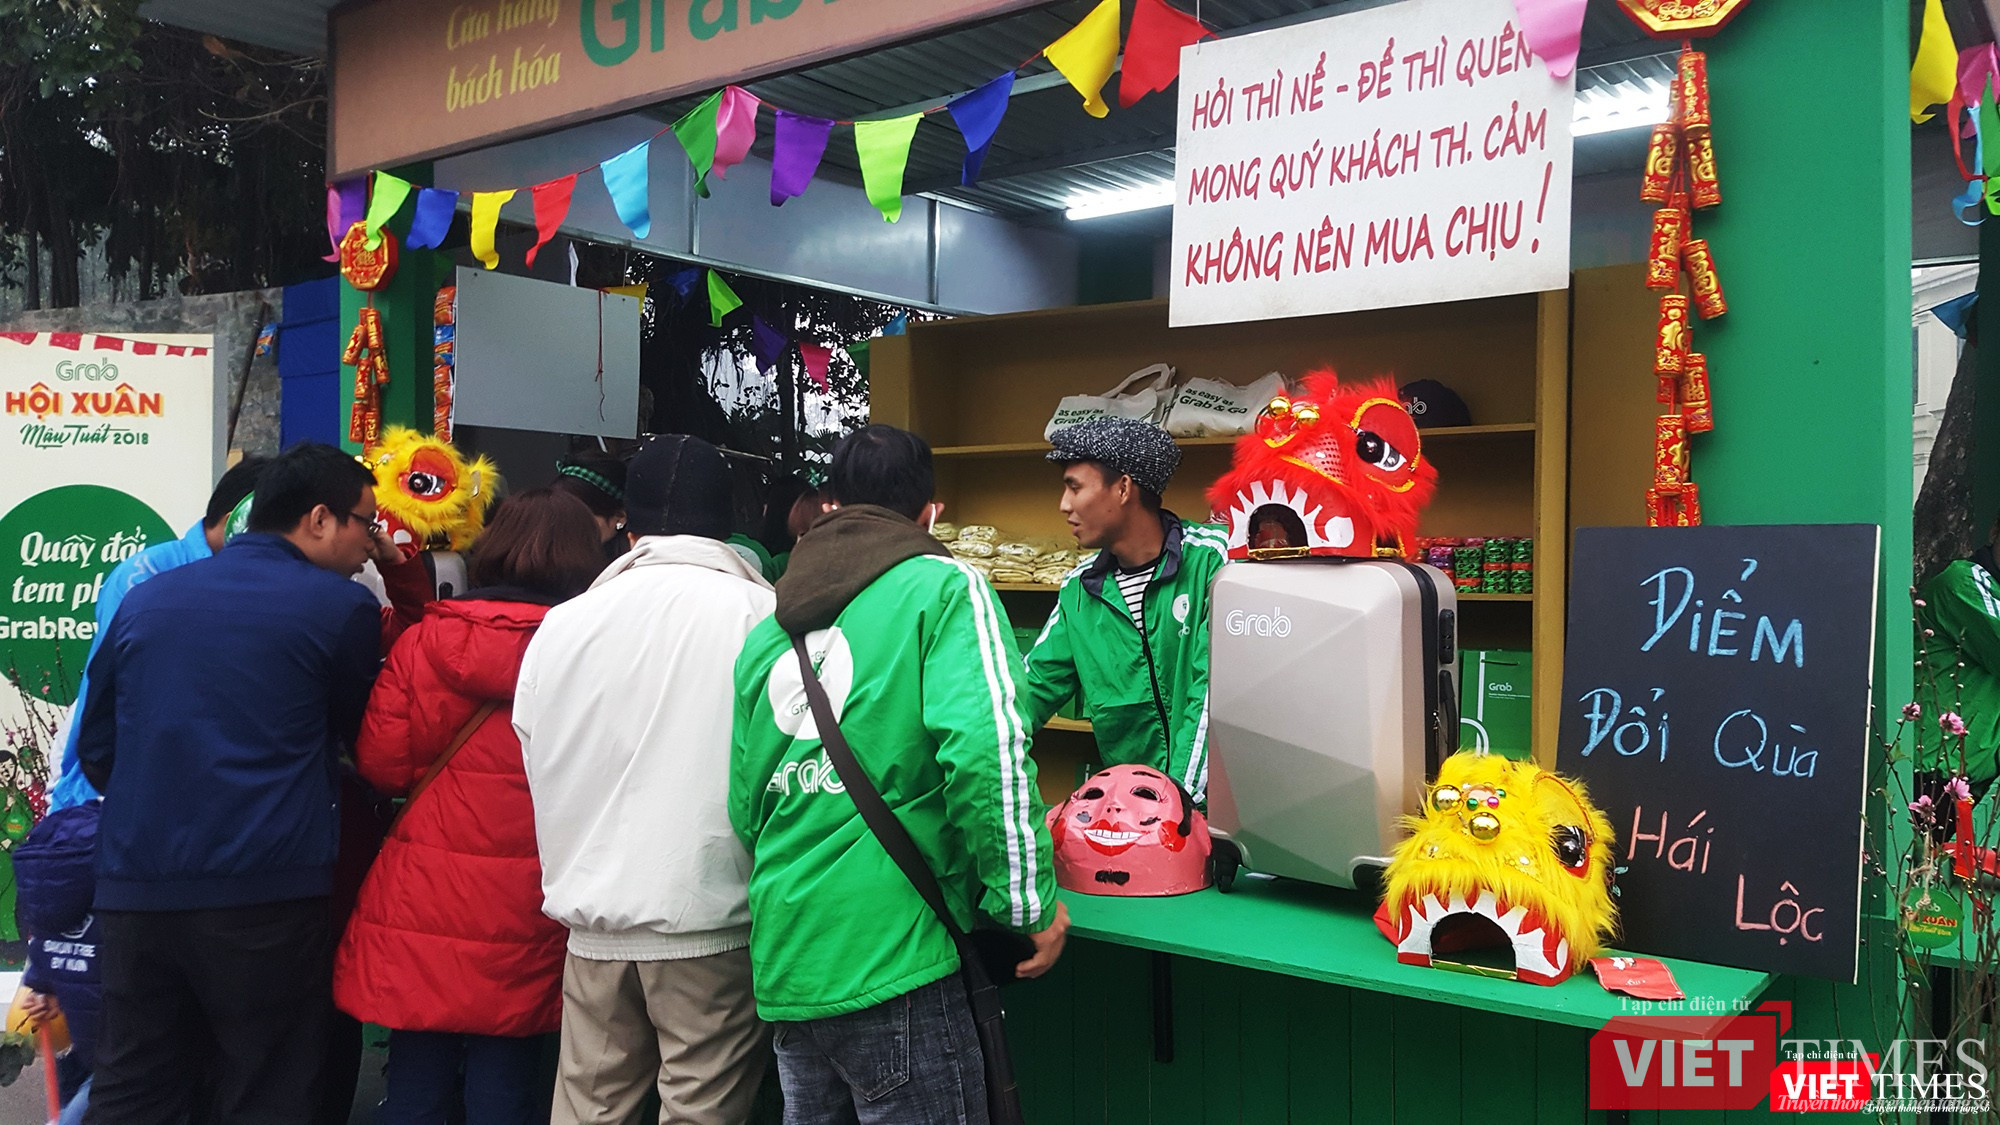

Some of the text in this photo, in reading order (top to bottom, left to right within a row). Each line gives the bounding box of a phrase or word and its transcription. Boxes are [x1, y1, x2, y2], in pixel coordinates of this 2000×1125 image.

[579, 0, 801, 67] Gra
[446, 44, 561, 113] bách hóa
[1192, 77, 1233, 131] HỎI
[1242, 69, 1283, 120] THÌ
[1291, 51, 1327, 115] NỂ
[1357, 37, 1394, 103] ĐỂ
[1403, 36, 1447, 91] THÌ
[1188, 100, 1547, 205] MONG QUÝ KHÁCH TH. CẢM
[1186, 227, 1284, 287] KHÔNG
[1294, 215, 1354, 276] NÊN
[1364, 213, 1434, 267] MUA
[55, 357, 119, 382] Grab
[5, 381, 164, 420] HỘI XUÂN
[1180, 395, 1212, 409] Grab
[1198, 391, 1222, 403] easy
[63, 423, 130, 446] Tuất
[113, 432, 149, 445] 2018
[1053, 416, 1085, 426] Grab
[20, 531, 97, 569] Quầy
[12, 575, 66, 604] tem
[1225, 606, 1292, 638] Grab
[1488, 682, 1513, 692] Grab
[1713, 709, 1819, 779] Quà
[1627, 805, 1825, 946] Hái Lộc
